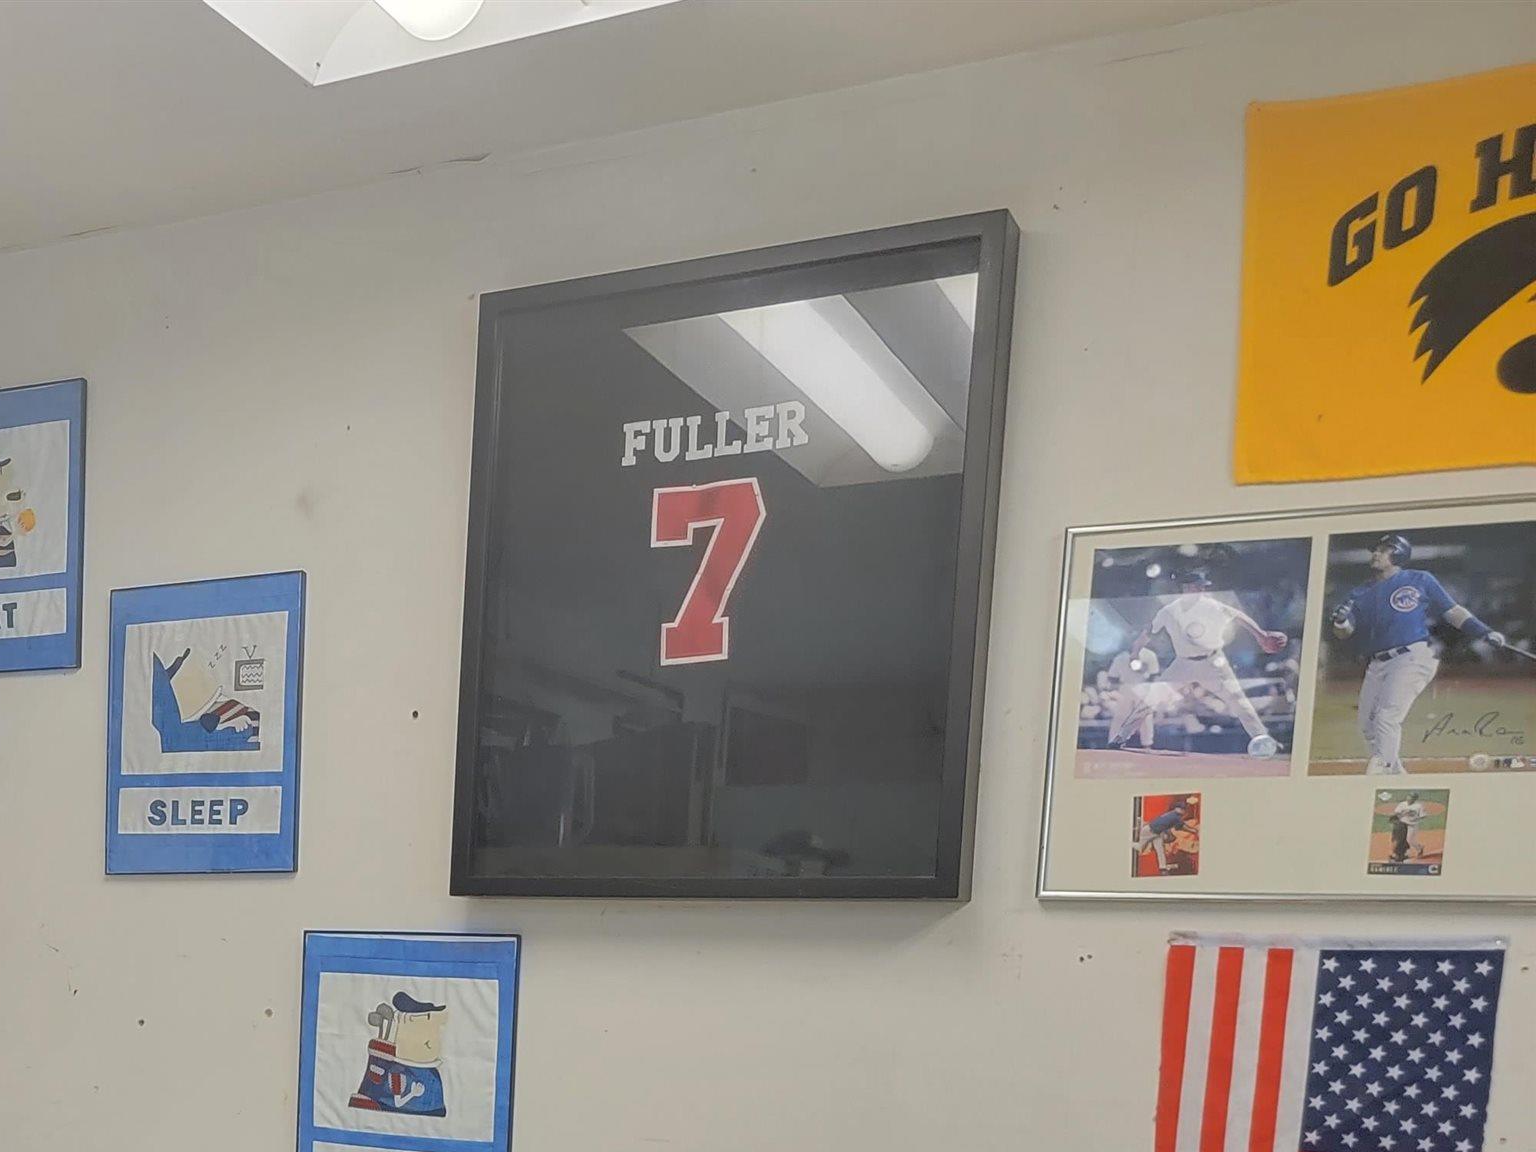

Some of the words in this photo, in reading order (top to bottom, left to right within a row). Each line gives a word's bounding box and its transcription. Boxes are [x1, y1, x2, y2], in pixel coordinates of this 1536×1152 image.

[1328, 165, 1437, 287] GO
[621, 400, 808, 466] FULLER
[650, 477, 766, 666] 7
[147, 798, 250, 826] SLEEP
